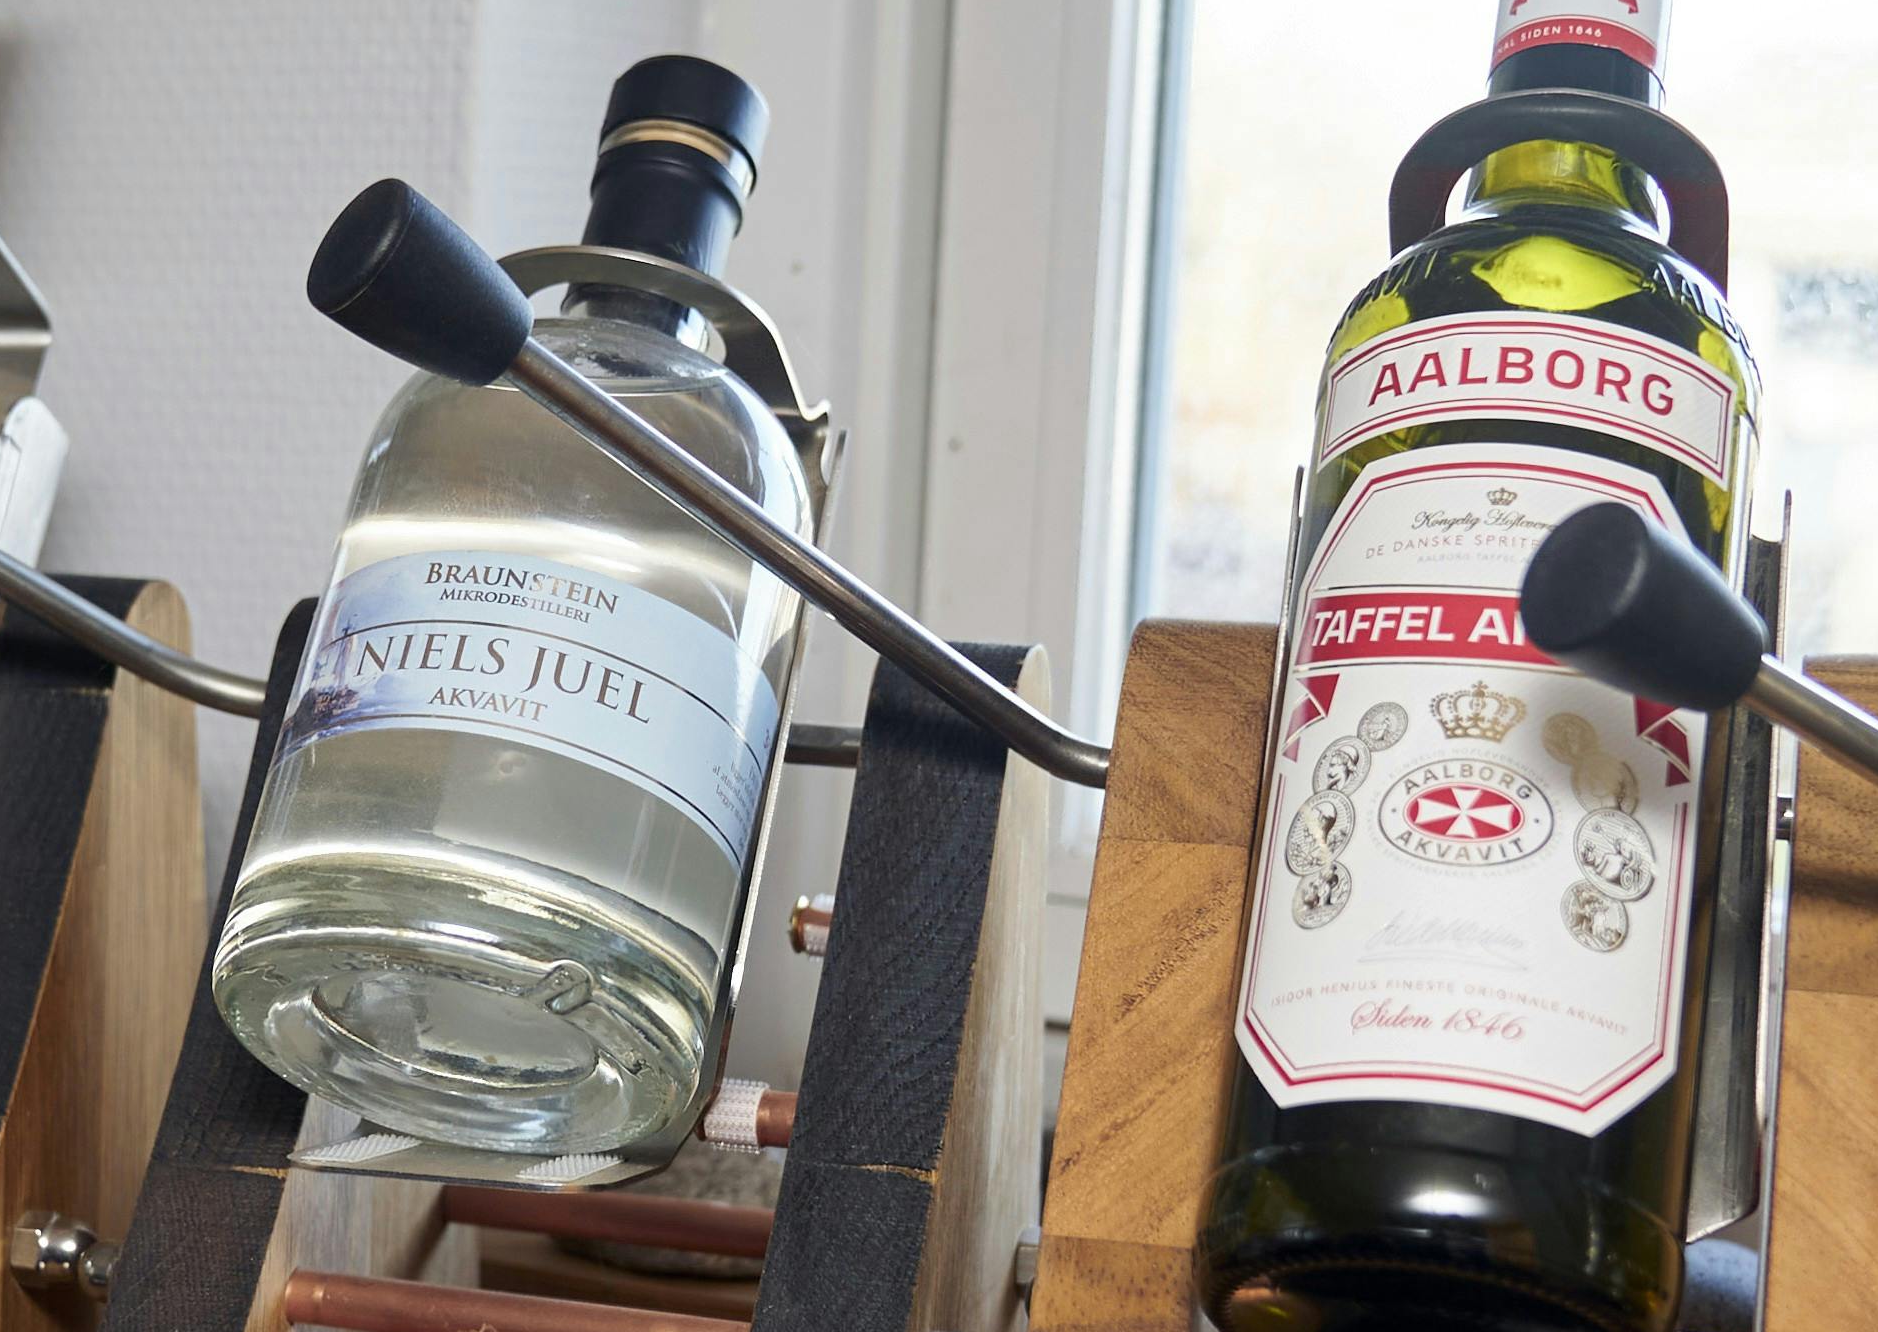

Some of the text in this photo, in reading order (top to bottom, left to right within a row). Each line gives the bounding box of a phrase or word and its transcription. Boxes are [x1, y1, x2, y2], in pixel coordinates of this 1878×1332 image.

[1520, 26, 1561, 42] SIDEN
[1568, 25, 1603, 38] 1846
[1368, 346, 1674, 416] AALBORG
[1411, 510, 1480, 533] Kongelig
[1365, 546, 1384, 559] DE
[1393, 534, 1464, 553] DANSKE
[425, 562, 620, 615] BRAUNSTEIN
[439, 588, 590, 623] MIKRODESTILLERI
[1311, 605, 1455, 647] TAFFEL
[355, 633, 650, 724] NIELS JUEL
[428, 686, 548, 722] AKVAVIT
[1403, 763, 1533, 800] AALBORG
[1395, 831, 1525, 861] AKVAVIT
[1270, 986, 1314, 1007] ISIDOR
[1320, 980, 1377, 995] HENIUS
[1385, 979, 1455, 994] FINESTE
[1464, 983, 1559, 1012] ORIGINALE
[1350, 999, 1526, 1040] Siden 1846
